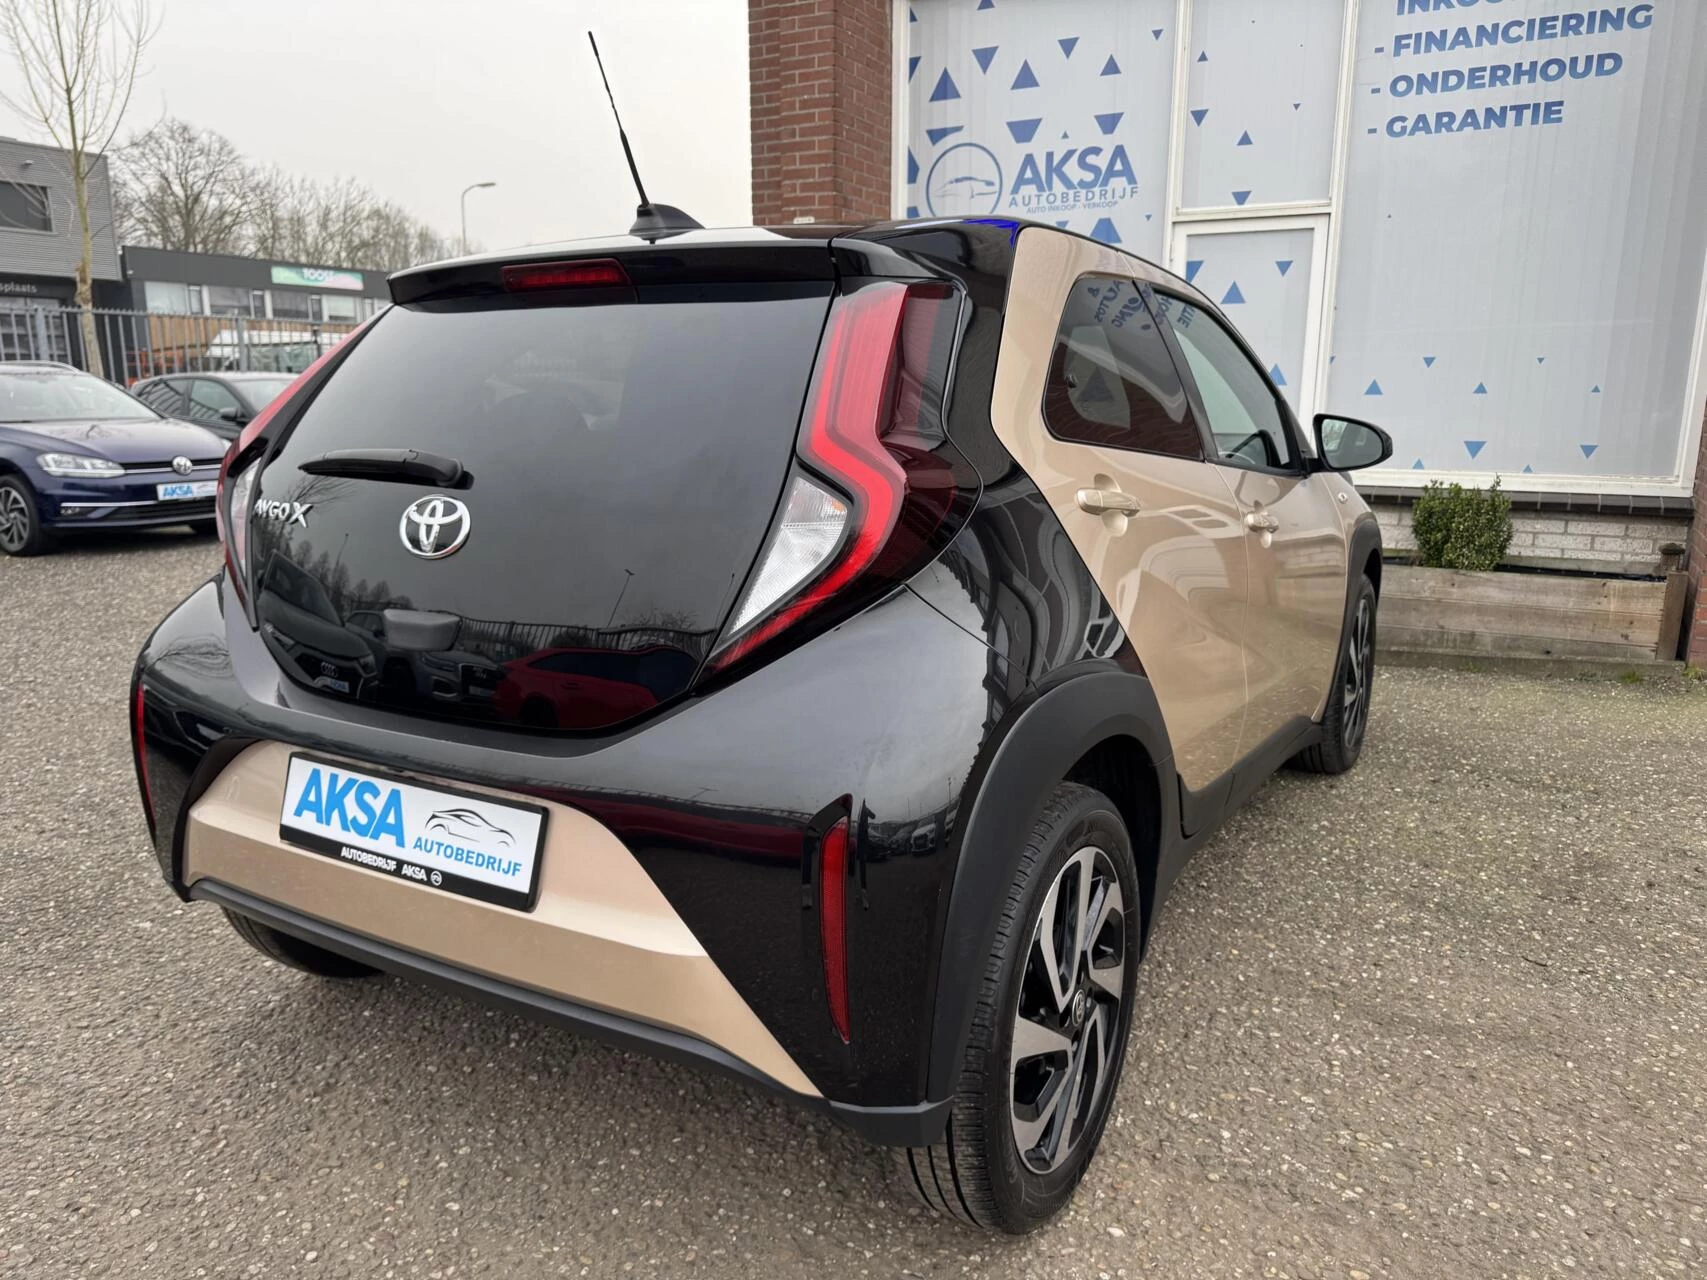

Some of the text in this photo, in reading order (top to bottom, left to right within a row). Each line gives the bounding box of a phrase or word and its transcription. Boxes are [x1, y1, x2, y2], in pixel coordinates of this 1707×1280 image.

[1393, 4, 1655, 57] FINANCIERING
[1389, 52, 1623, 97] ONDERHOUD
[1386, 100, 1564, 138] GARANTIE
[1009, 144, 1138, 195] AKSA
[1009, 186, 1138, 208] AUTOBEDRIJF
[293, 768, 522, 877] AKSA AUTOBEDRIJF
[341, 847, 427, 881] AUTOBEDRIJF AKSA
